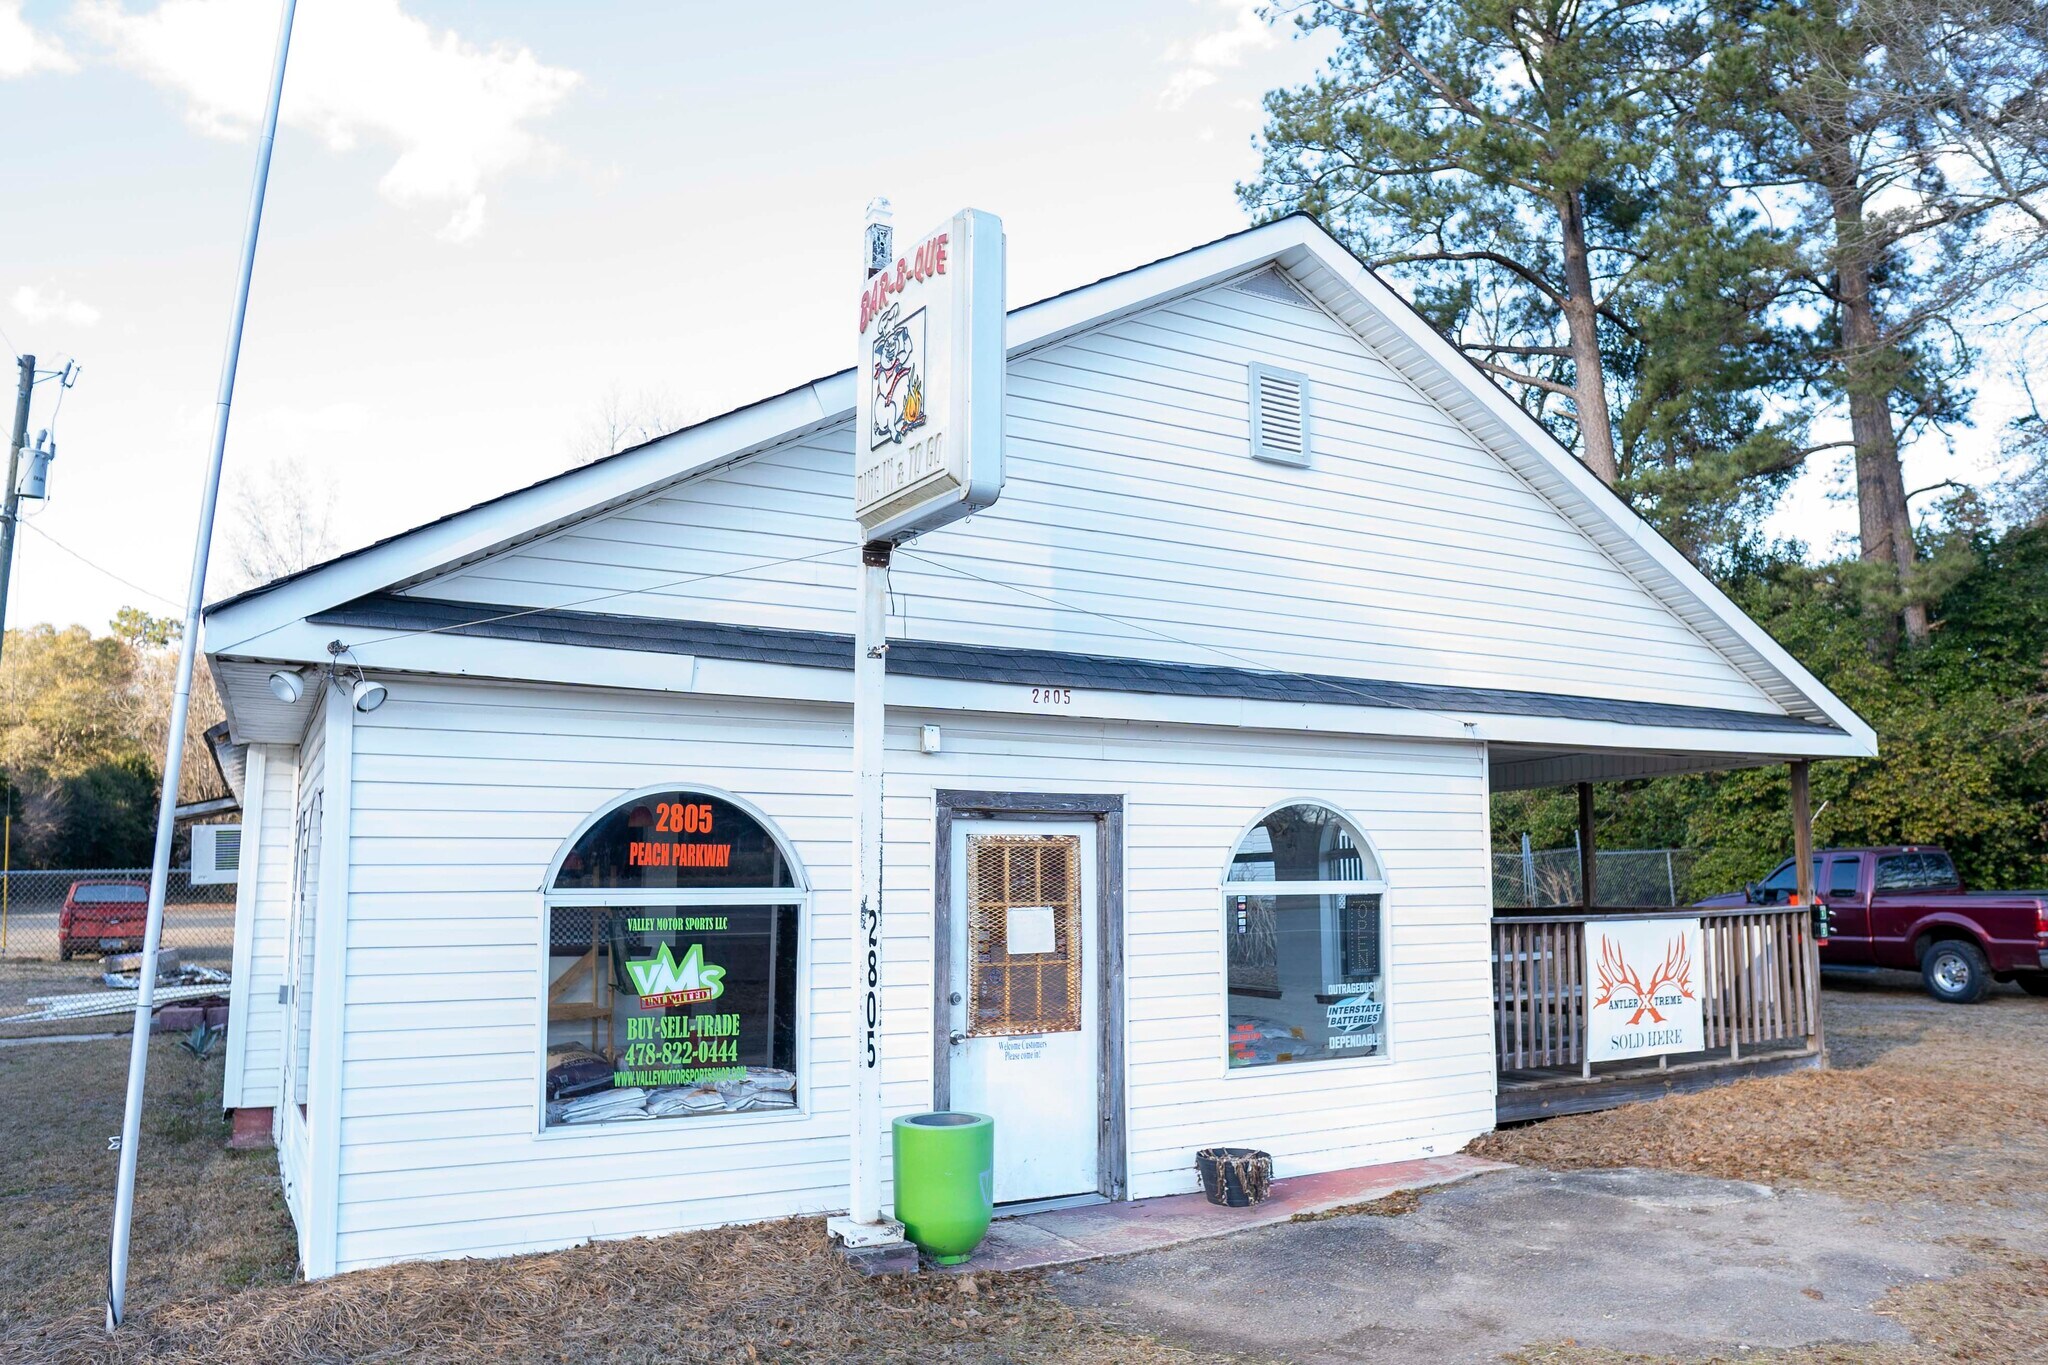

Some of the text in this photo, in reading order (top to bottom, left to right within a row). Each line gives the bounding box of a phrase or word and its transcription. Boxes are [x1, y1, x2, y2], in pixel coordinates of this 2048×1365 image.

[860, 233, 948, 334] BAR-B-QUE
[897, 461, 905, 485] &
[908, 442, 922, 481] TO
[926, 432, 942, 475] GO
[1032, 688, 1071, 704] 2805
[656, 803, 713, 833] 2805
[630, 842, 731, 867] PEACH PARKWAY
[627, 917, 728, 931] VALLEY MOTOR SPORTS LLC
[1358, 904, 1368, 968] OPEN
[644, 990, 708, 1007] UNLIMITED
[867, 909, 877, 1069] 2805
[1329, 1003, 1381, 1015] INTERSTATE
[1609, 999, 1639, 1010] ANTLER
[627, 1014, 740, 1040] BUY-SELL-TRADE
[1331, 1014, 1378, 1025] BATTERIES
[998, 1040, 1047, 1051] Welcome Customers
[1329, 1033, 1381, 1049] DEPENDABLE
[1611, 1029, 1682, 1050] SOLD HERE
[625, 1040, 738, 1066] 478-822-0444
[1005, 1051, 1020, 1061] Please
[1021, 1052, 1033, 1060] come
